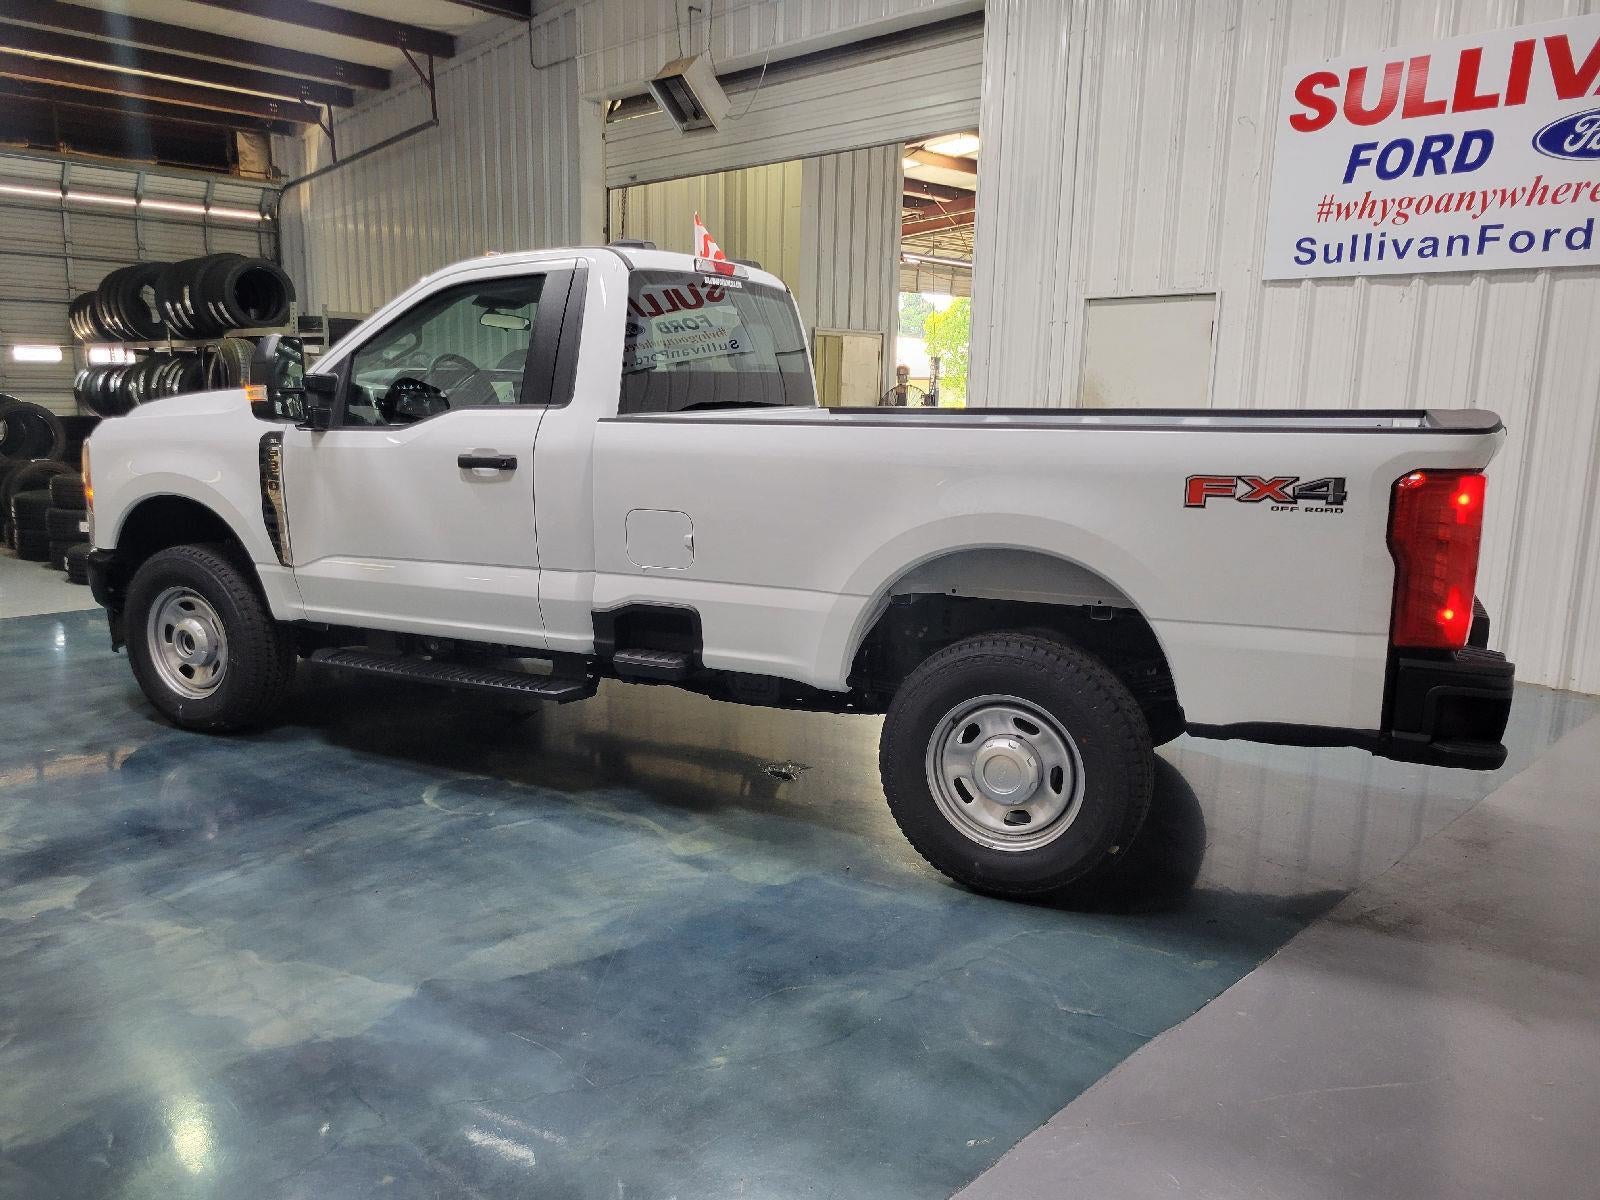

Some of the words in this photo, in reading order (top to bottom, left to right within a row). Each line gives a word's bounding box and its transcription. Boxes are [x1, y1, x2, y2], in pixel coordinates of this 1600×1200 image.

[1289, 34, 1600, 132] SULLIV
[1342, 129, 1494, 185] FORD
[1293, 218, 1595, 266] SullivanFord
[1184, 475, 1347, 508] FX4
